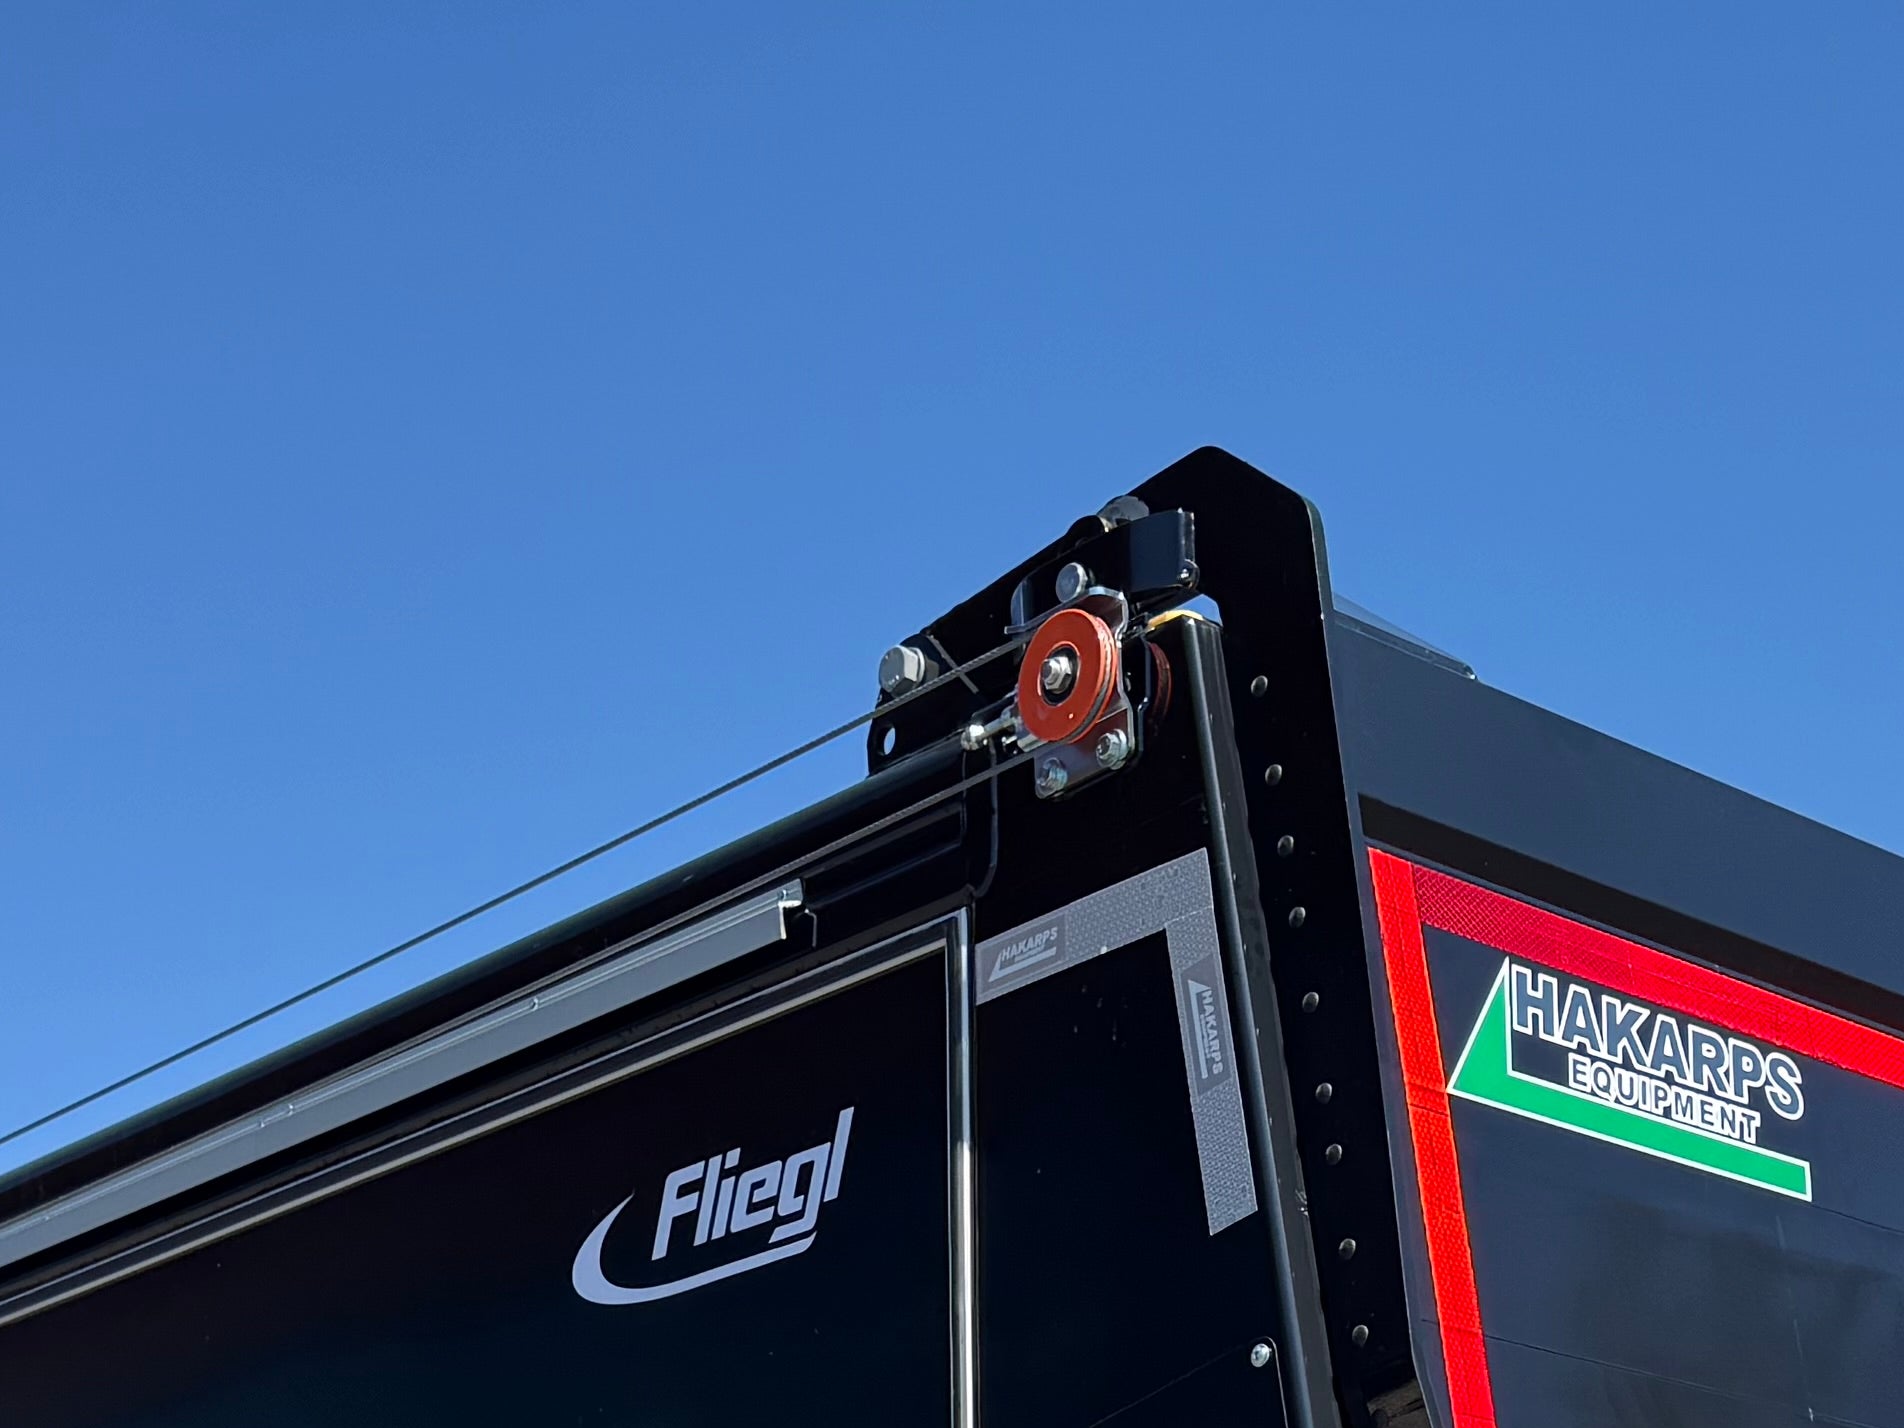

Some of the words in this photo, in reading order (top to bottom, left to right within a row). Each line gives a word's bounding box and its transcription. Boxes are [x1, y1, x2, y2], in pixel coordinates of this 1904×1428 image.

[1001, 927, 1058, 961] HAKARPS
[1201, 990, 1223, 1074] HAKARPS
[1510, 962, 1805, 1121] HAKARPS
[1567, 1052, 1761, 1144] EQUIPMENT
[651, 1106, 855, 1261] Fliegl
